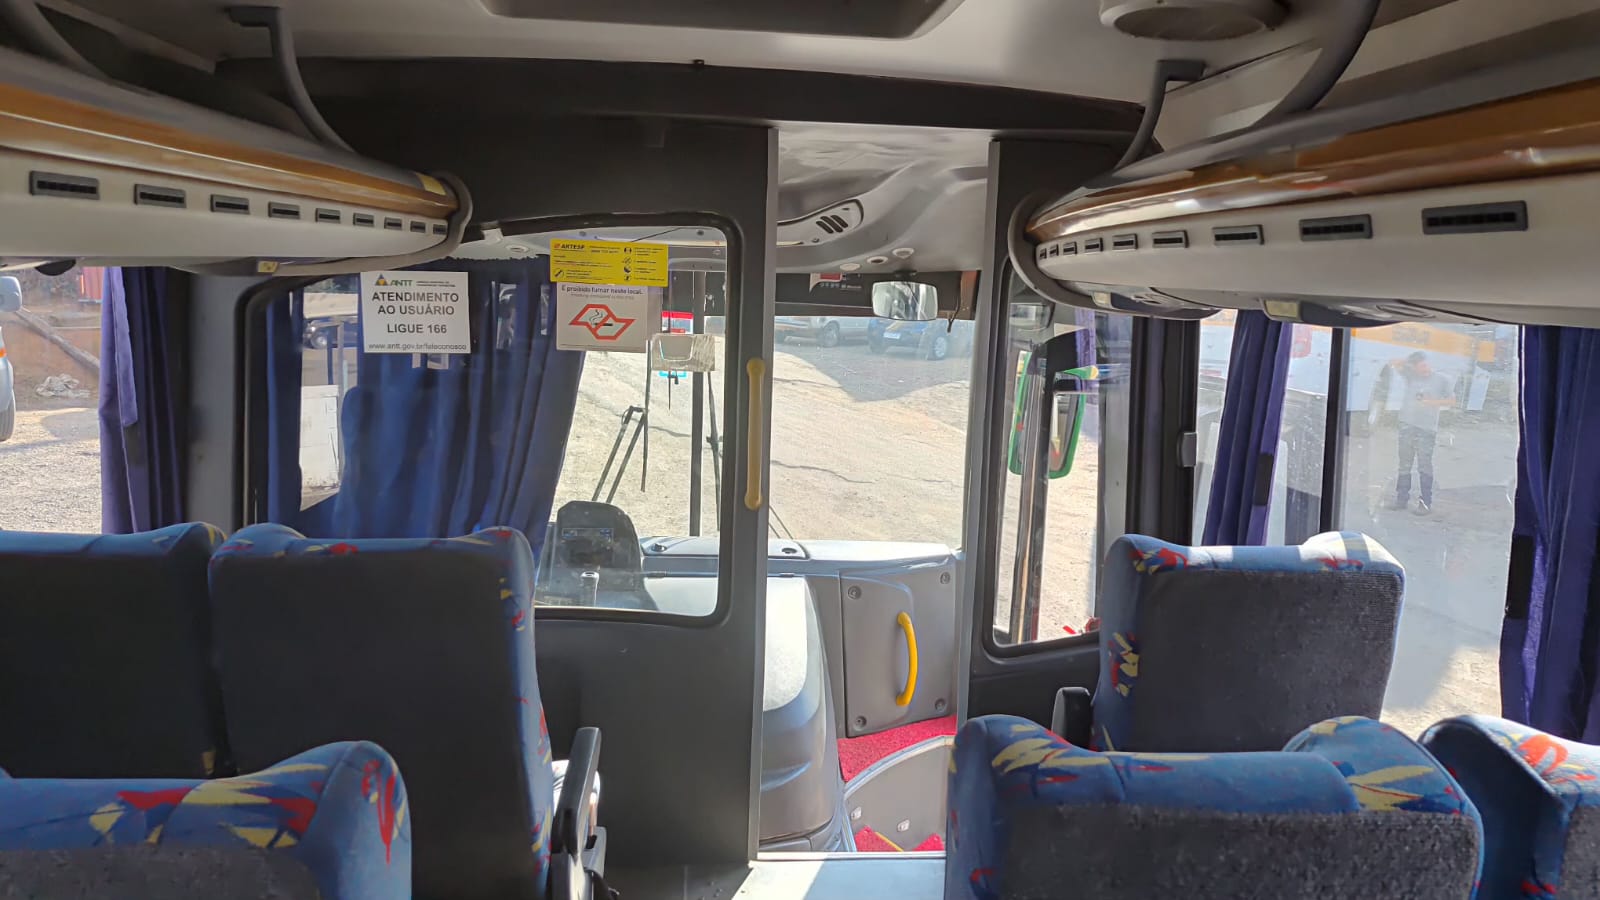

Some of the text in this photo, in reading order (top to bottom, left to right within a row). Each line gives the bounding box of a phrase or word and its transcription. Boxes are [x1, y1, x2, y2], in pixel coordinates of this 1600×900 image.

[390, 279, 413, 287] ANTT
[372, 291, 459, 303] ATENDIMENTO
[378, 303, 455, 316] AO USUÁRIO
[387, 323, 447, 334] LIGUE 166
